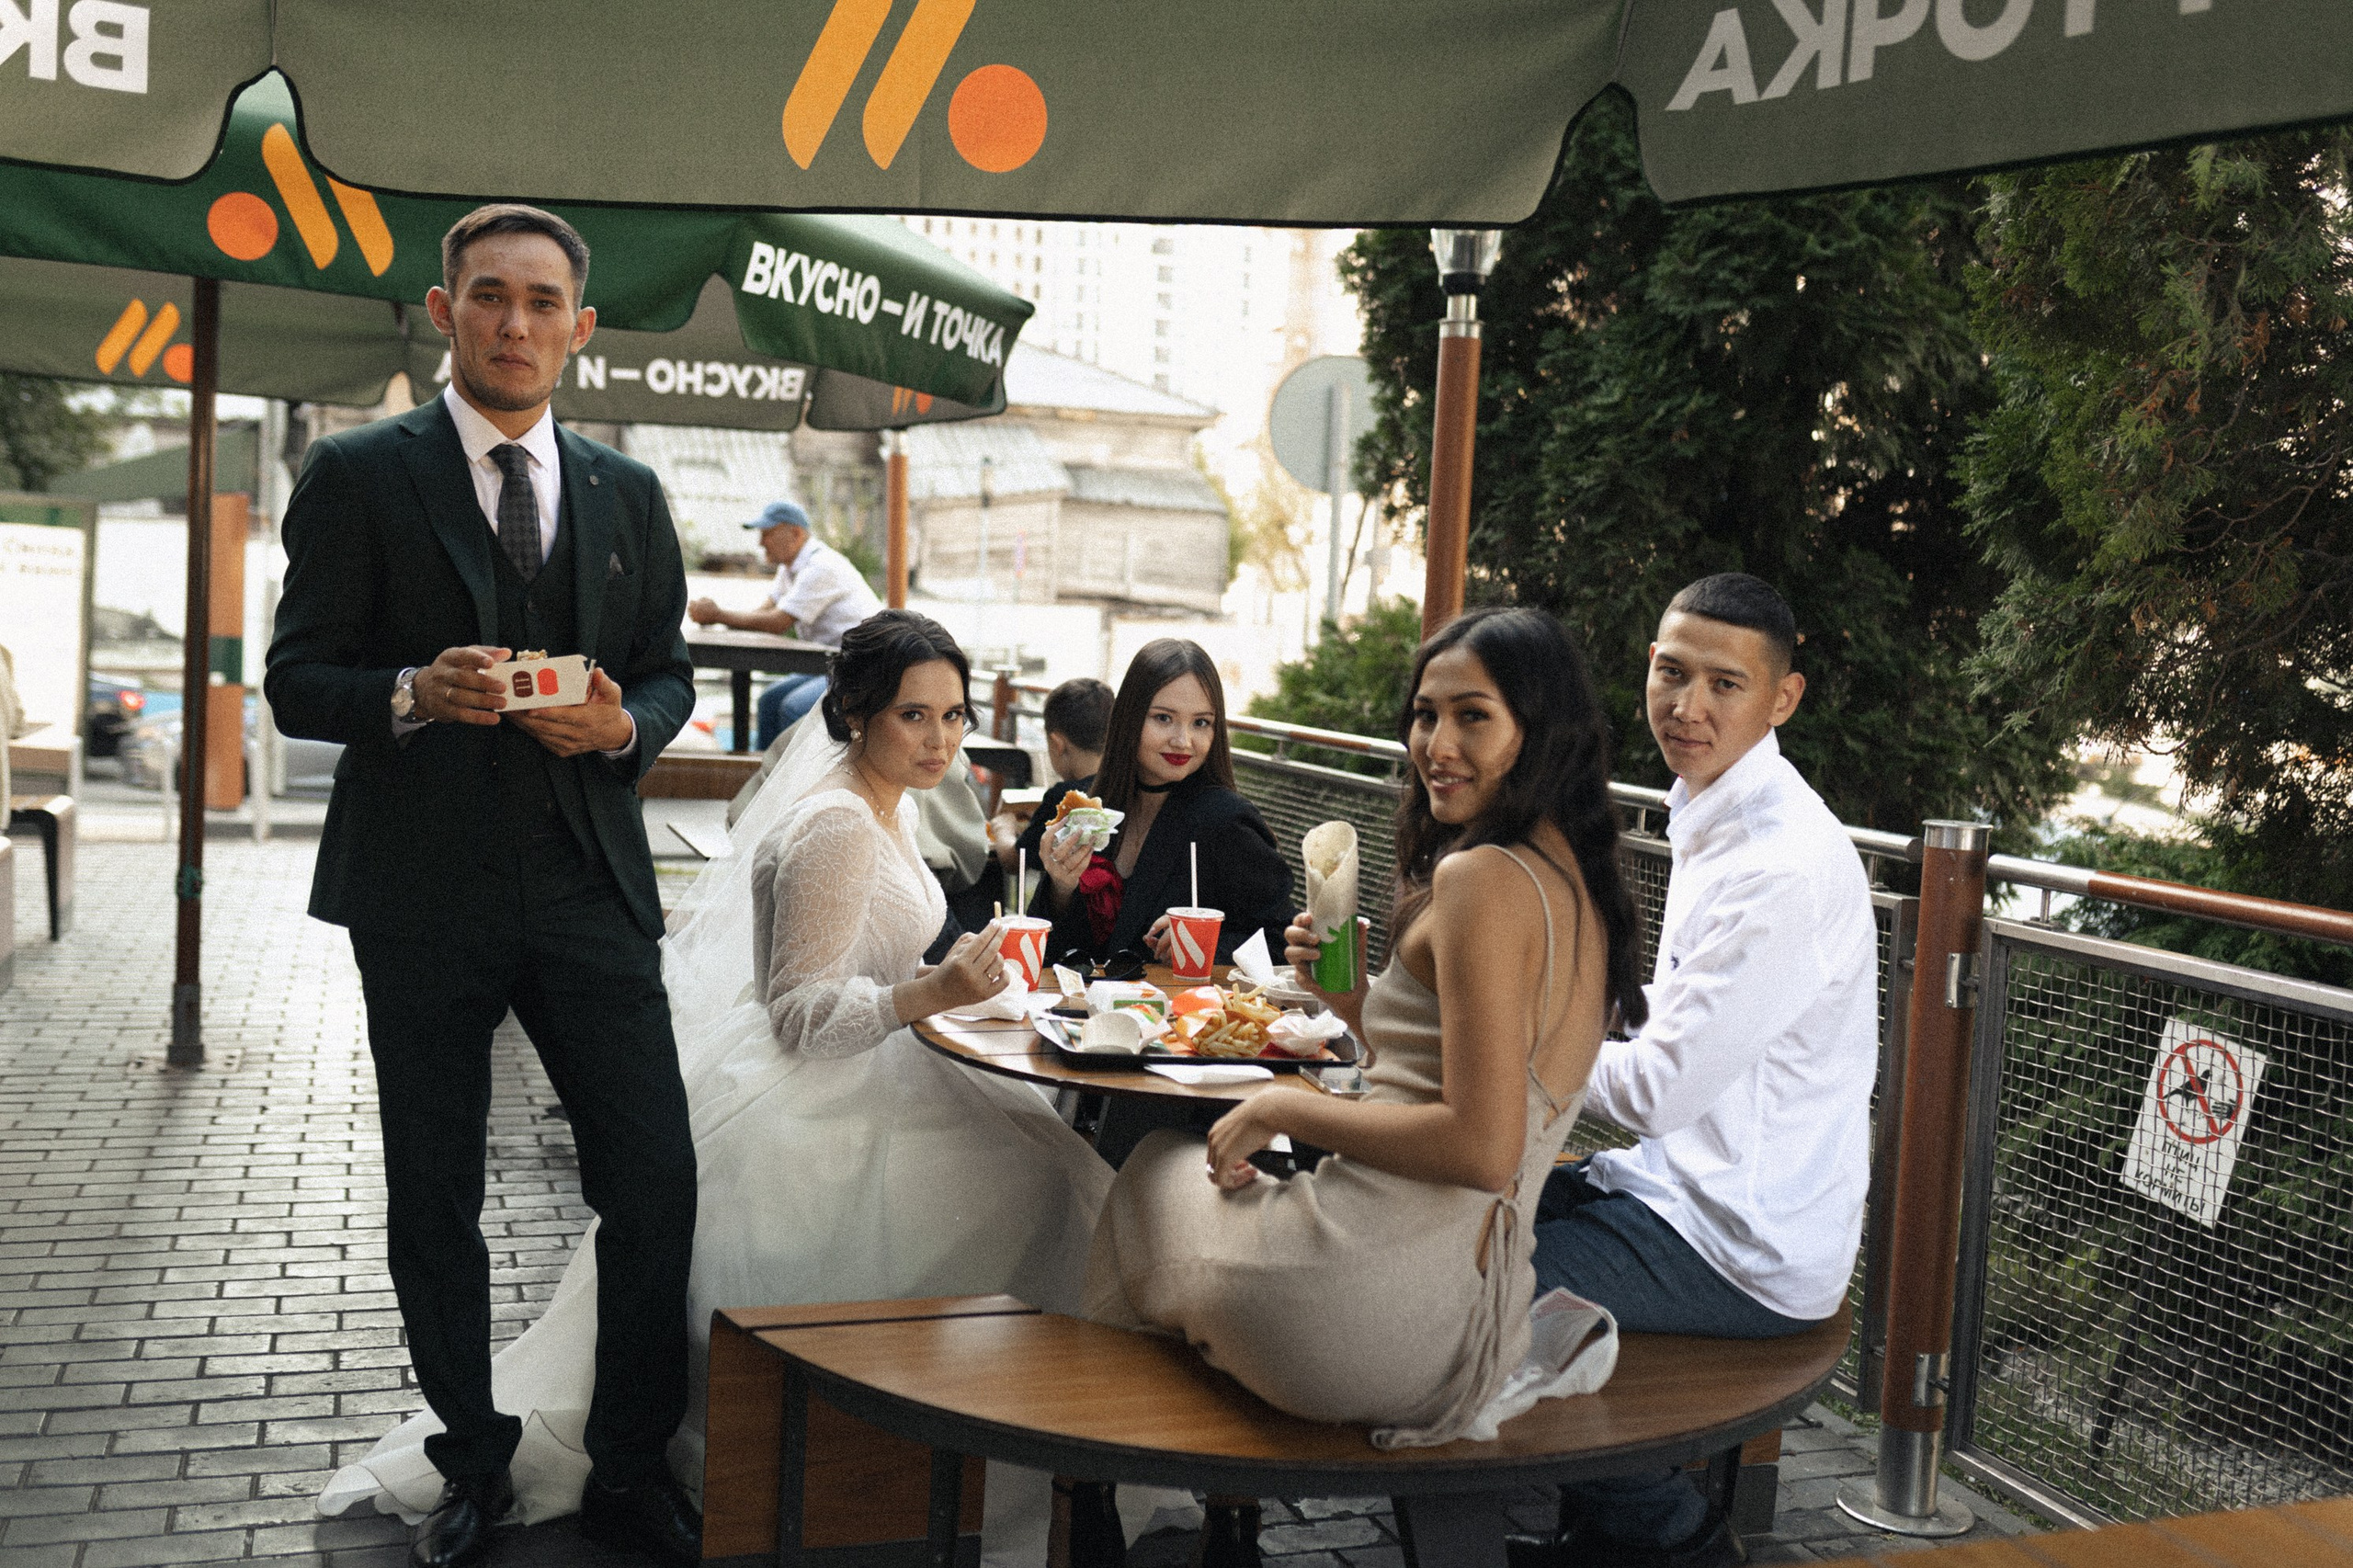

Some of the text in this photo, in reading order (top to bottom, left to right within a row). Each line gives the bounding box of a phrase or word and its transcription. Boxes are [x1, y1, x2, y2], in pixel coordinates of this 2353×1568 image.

[929, 300, 1005, 368] ТОЧКА
[2161, 1141, 2200, 1172] ПТИЦ
[2164, 1163, 2185, 1184] НЕ
